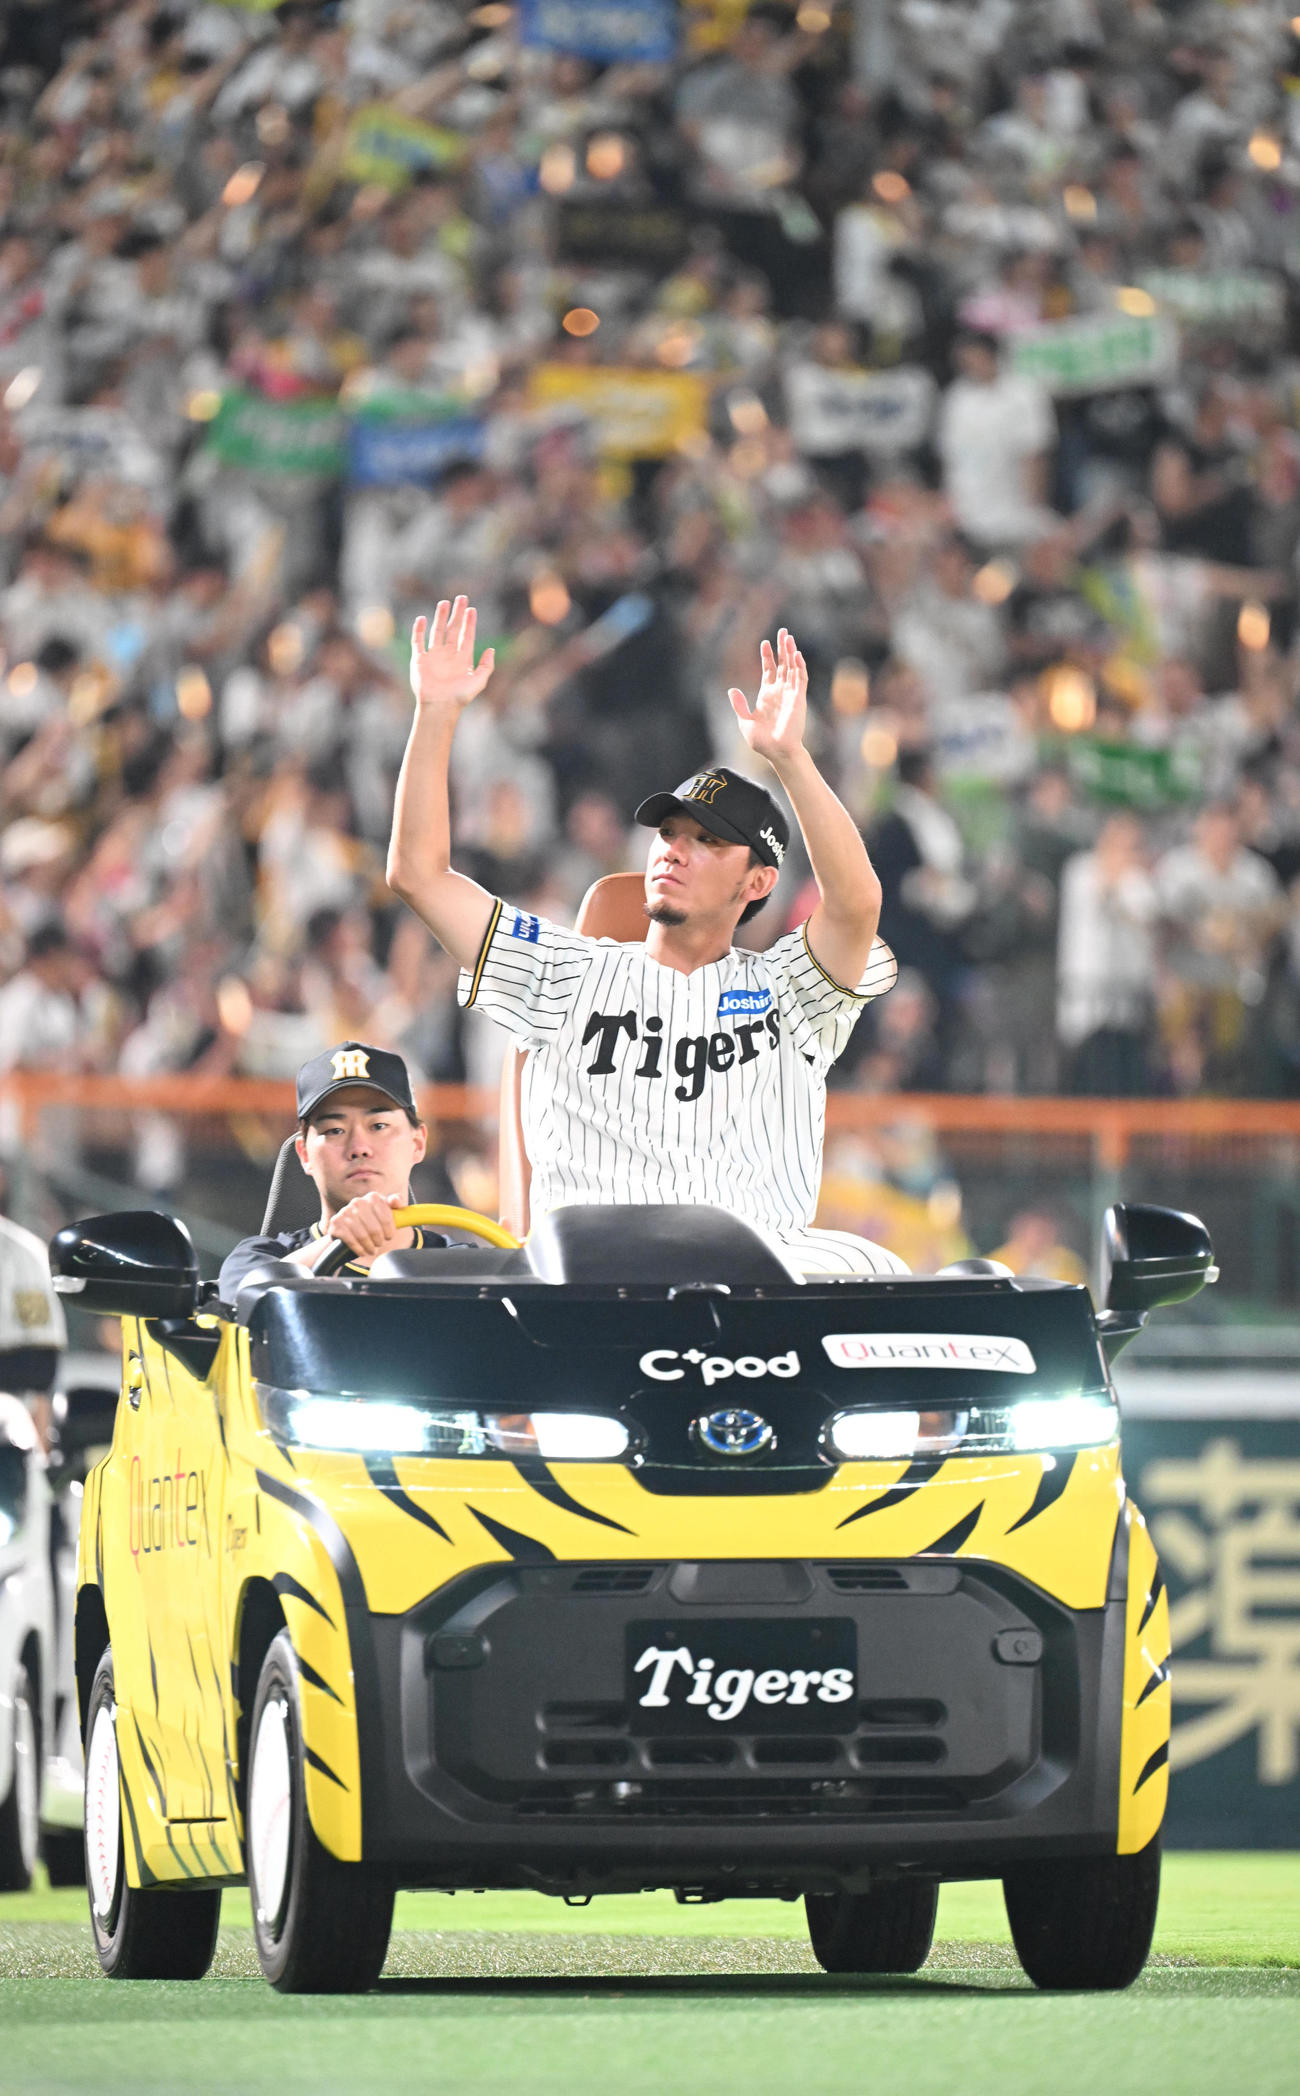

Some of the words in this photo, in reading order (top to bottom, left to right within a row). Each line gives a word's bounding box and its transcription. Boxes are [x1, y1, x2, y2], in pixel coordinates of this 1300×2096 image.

[582, 1009, 780, 1102] Tigers
[841, 1341, 1021, 1367] Quantex
[634, 1646, 854, 1721] Tigers
